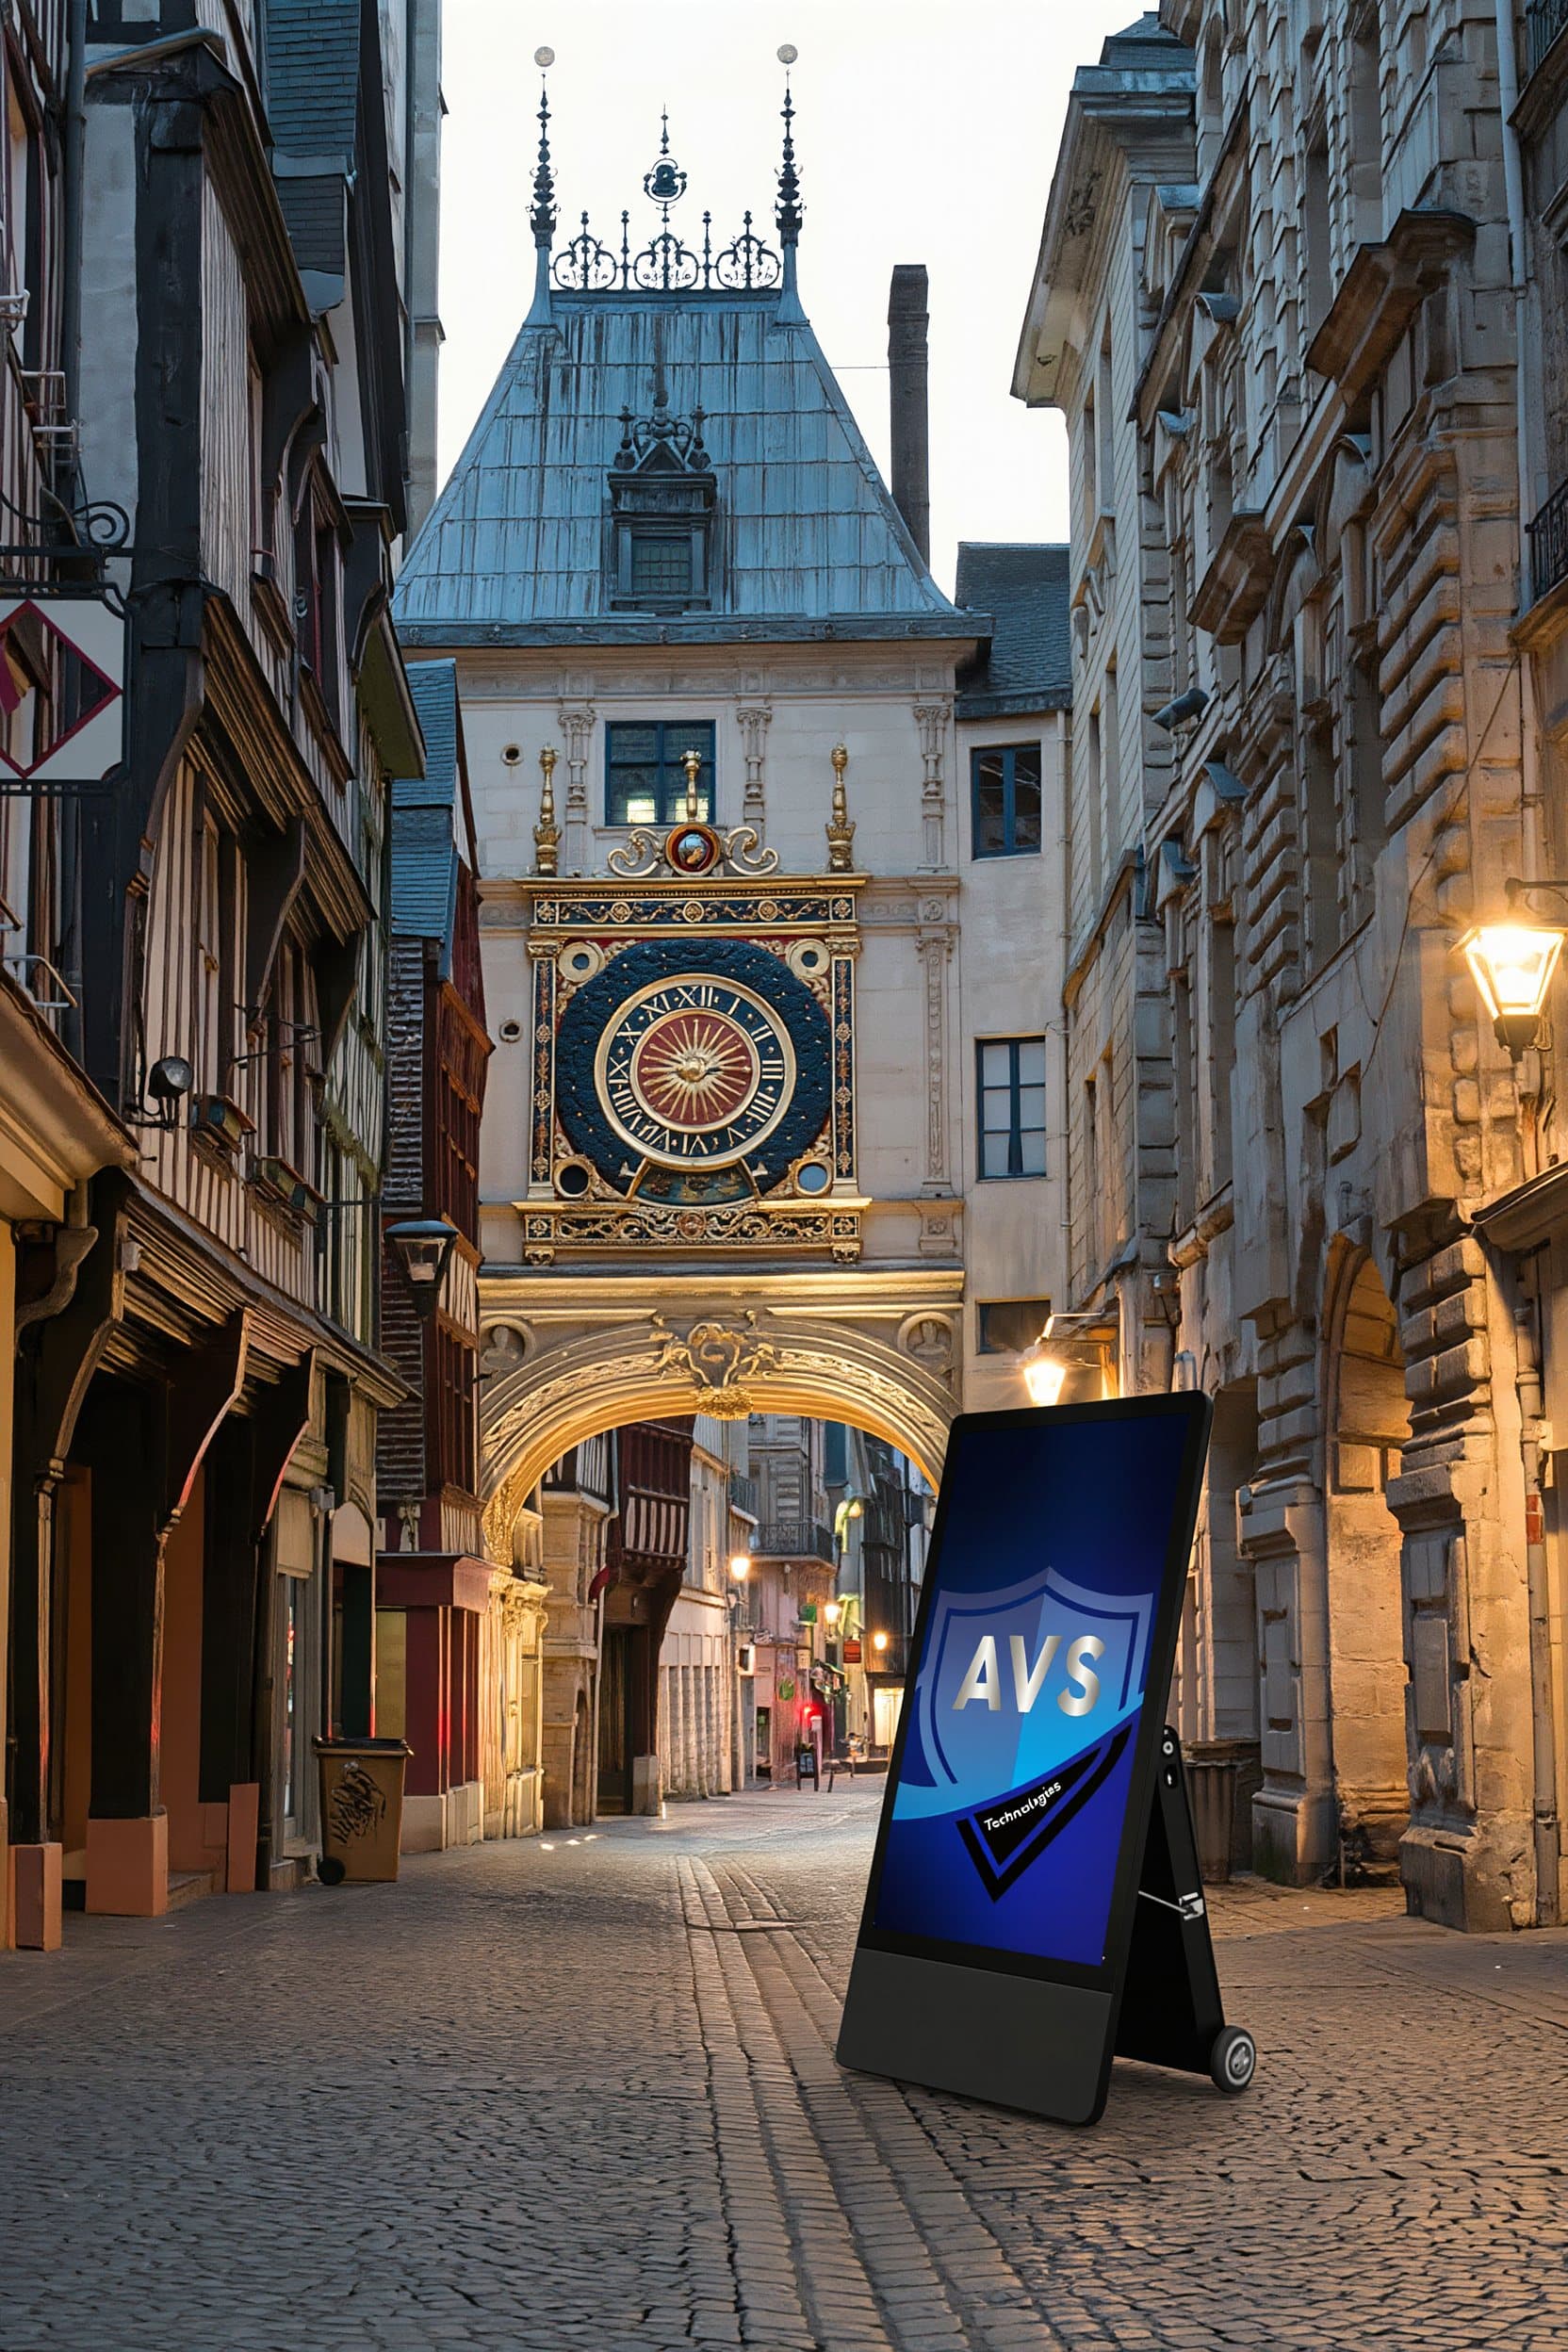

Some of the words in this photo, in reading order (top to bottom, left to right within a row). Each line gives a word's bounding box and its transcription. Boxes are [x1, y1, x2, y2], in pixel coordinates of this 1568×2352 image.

[640, 993, 672, 1021] XI
[678, 986, 712, 1007] XII
[727, 998, 741, 1016] I
[616, 1021, 642, 1046] X
[751, 1024, 774, 1042] II
[609, 1056, 630, 1085] IX
[761, 1059, 784, 1081] III
[612, 1088, 644, 1131] VIII
[745, 1091, 776, 1123] IIII
[681, 1134, 710, 1155] VI
[726, 1126, 747, 1148] V
[952, 1635, 1105, 1717] AVS
[983, 1781, 1062, 1832] Technologies
